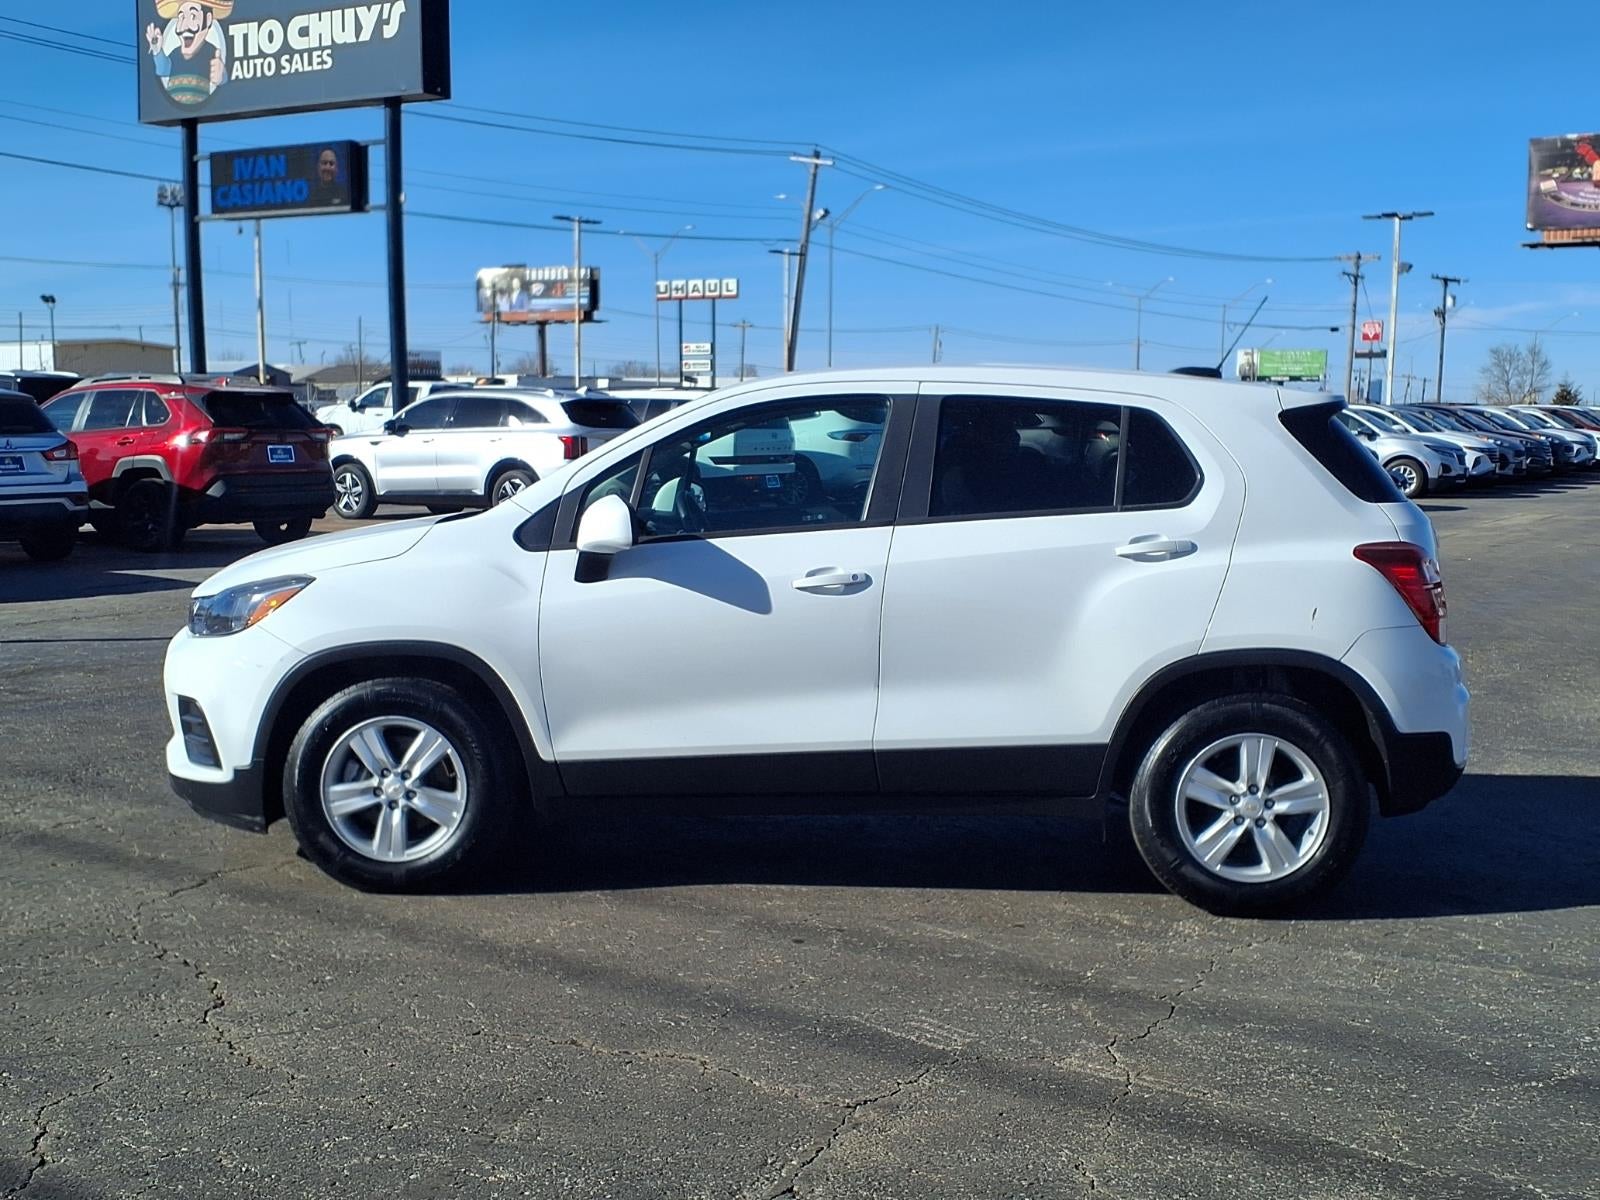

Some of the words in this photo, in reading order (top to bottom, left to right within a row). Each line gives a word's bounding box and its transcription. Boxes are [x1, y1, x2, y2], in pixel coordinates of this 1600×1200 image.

[229, 19, 284, 57] TIO
[287, 0, 406, 50] CHUY'S
[231, 57, 276, 80] AUTO
[280, 50, 333, 75] SALES
[233, 154, 287, 180] IVAN
[215, 179, 309, 207] CASIANO
